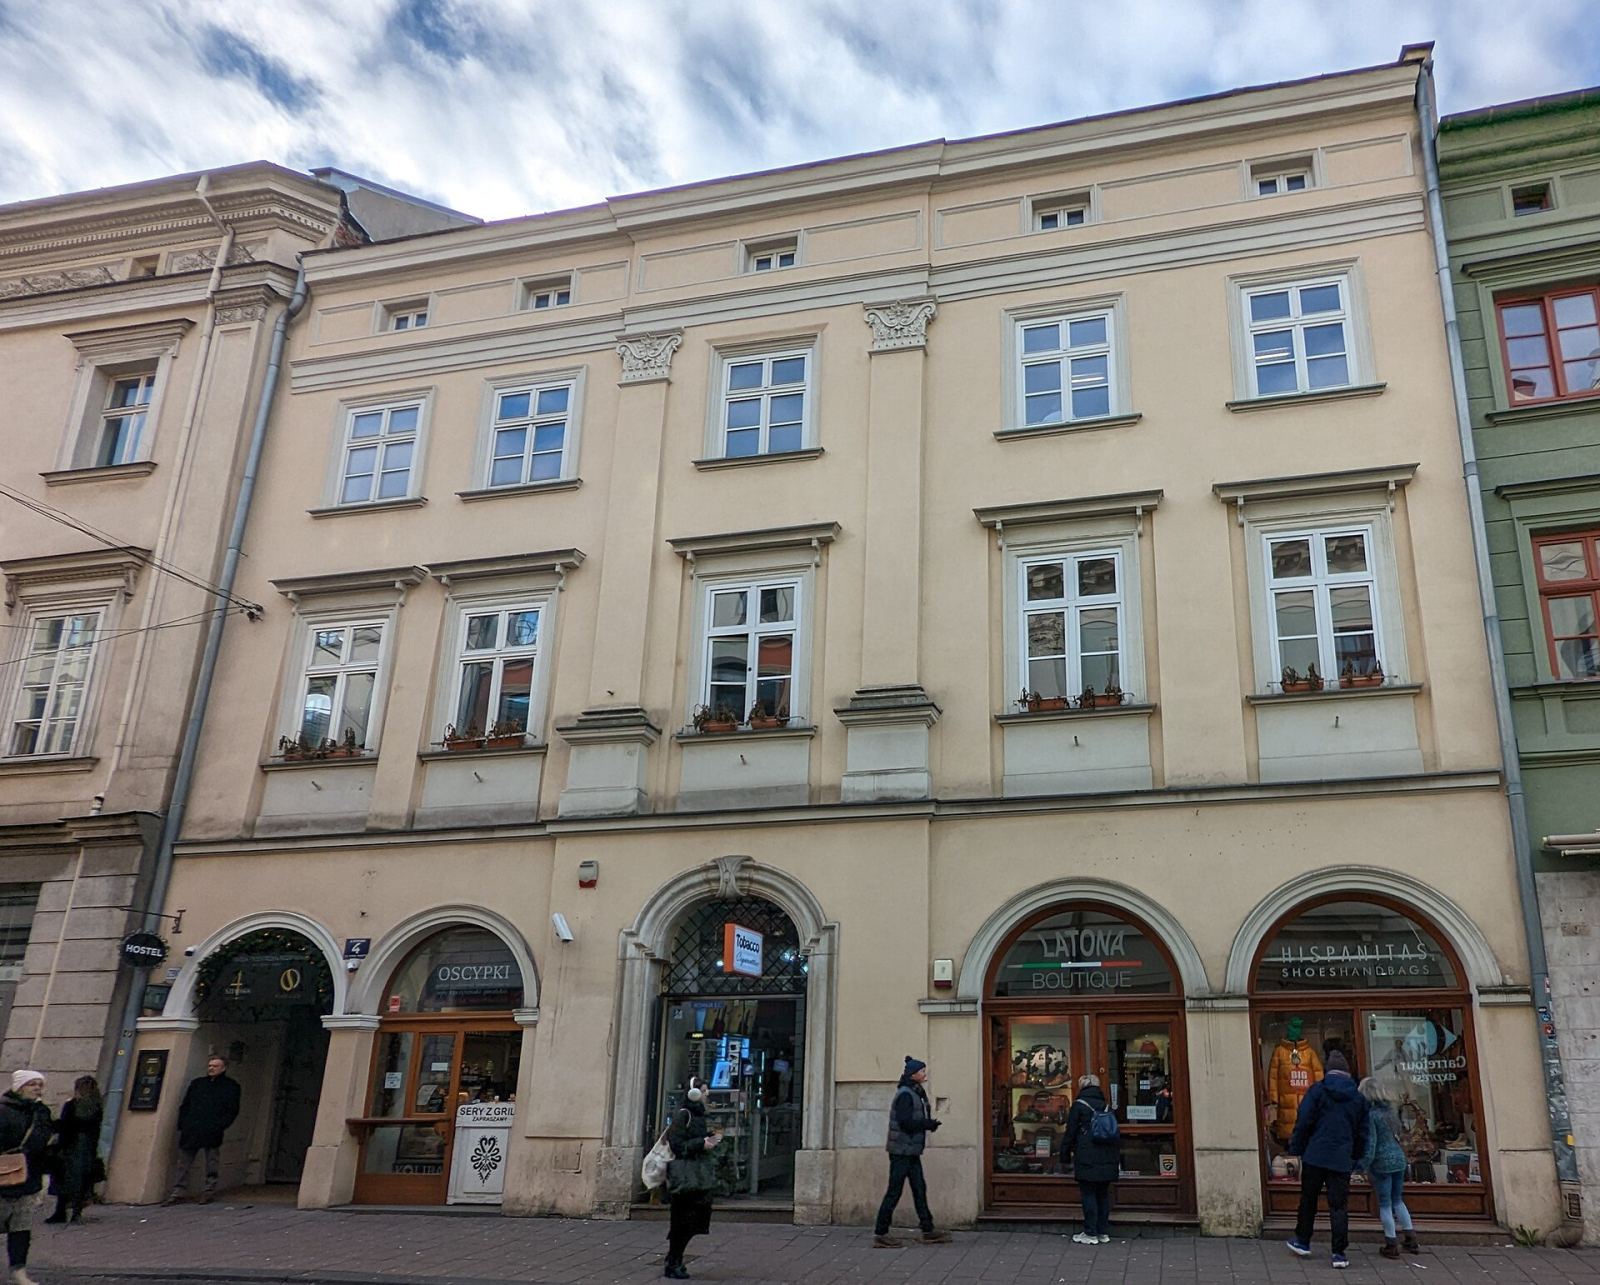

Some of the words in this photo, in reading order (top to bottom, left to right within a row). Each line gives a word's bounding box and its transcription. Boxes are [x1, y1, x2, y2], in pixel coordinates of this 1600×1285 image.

[351, 942, 362, 954] 4
[736, 934, 760, 953] Tobacco
[1038, 928, 1125, 957] LATONA
[125, 944, 163, 957] HOSTEL
[438, 964, 510, 981] OSCYPKI
[1032, 970, 1132, 990] BOUTIQUE
[1290, 1070, 1308, 1080] BIG
[1290, 1079, 1310, 1088] SALE
[459, 1107, 484, 1116] SERY
[486, 1107, 492, 1116] Z
